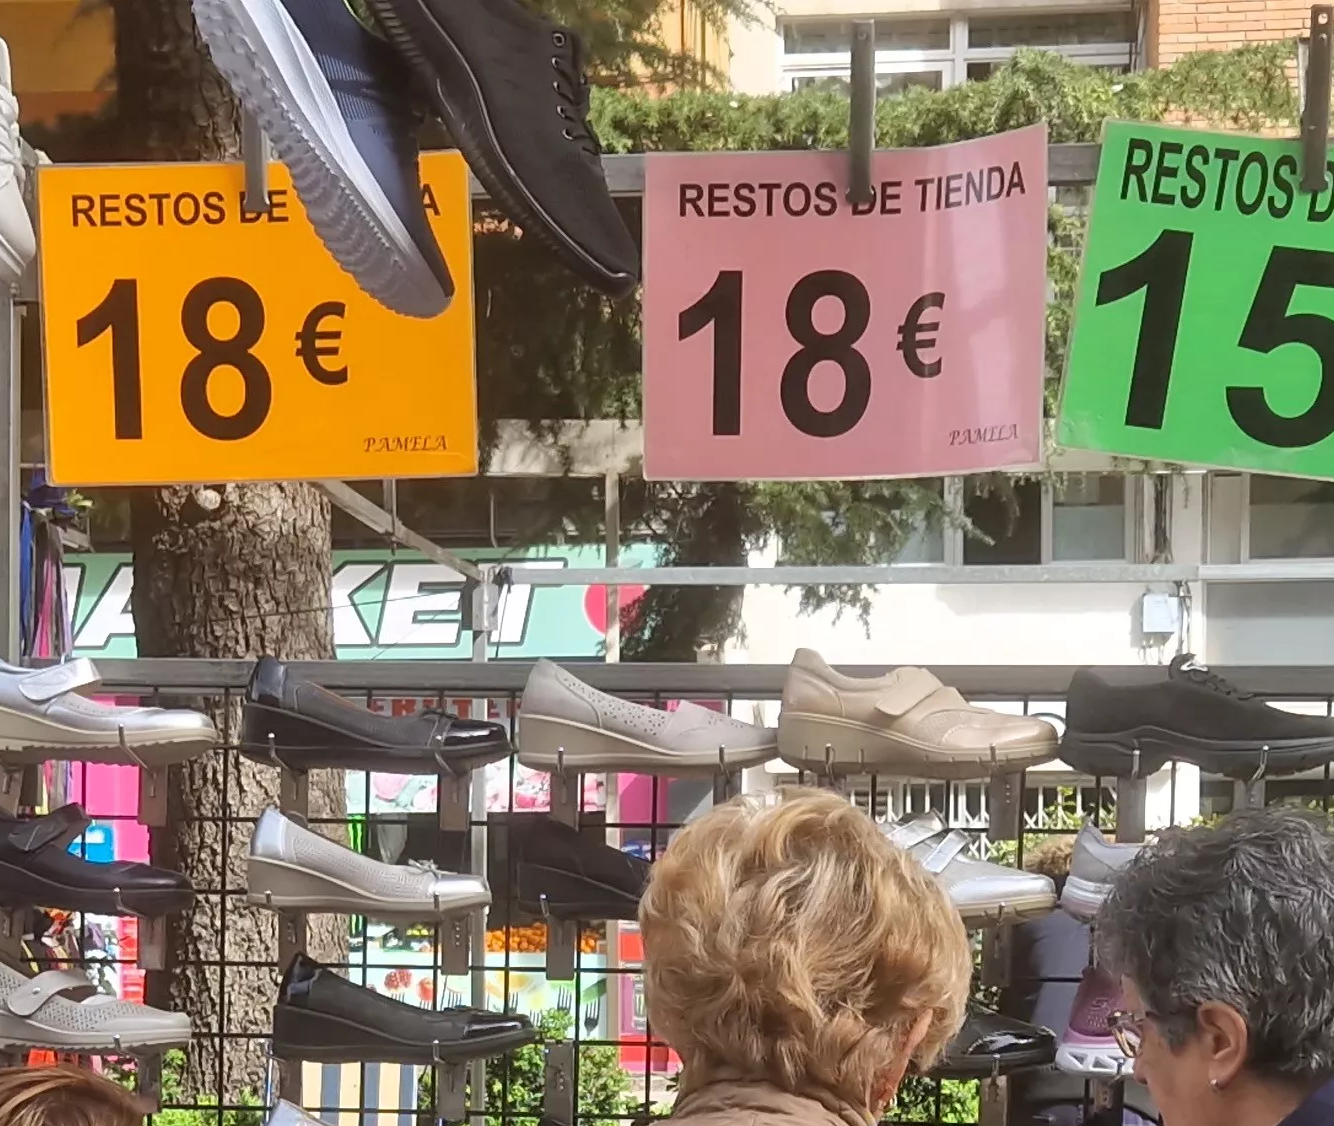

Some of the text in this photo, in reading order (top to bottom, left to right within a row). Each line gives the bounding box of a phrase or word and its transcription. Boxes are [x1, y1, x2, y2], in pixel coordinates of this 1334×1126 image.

[679, 182, 838, 218] RESTOS
[914, 161, 1027, 214] TIENDA
[1119, 137, 1299, 219] RESTOS
[70, 191, 226, 228] RESTOS
[76, 277, 348, 442] 18 €
[678, 269, 946, 438] 18 €
[363, 435, 448, 453] PAMELA
[949, 423, 1019, 446] PAMELA
